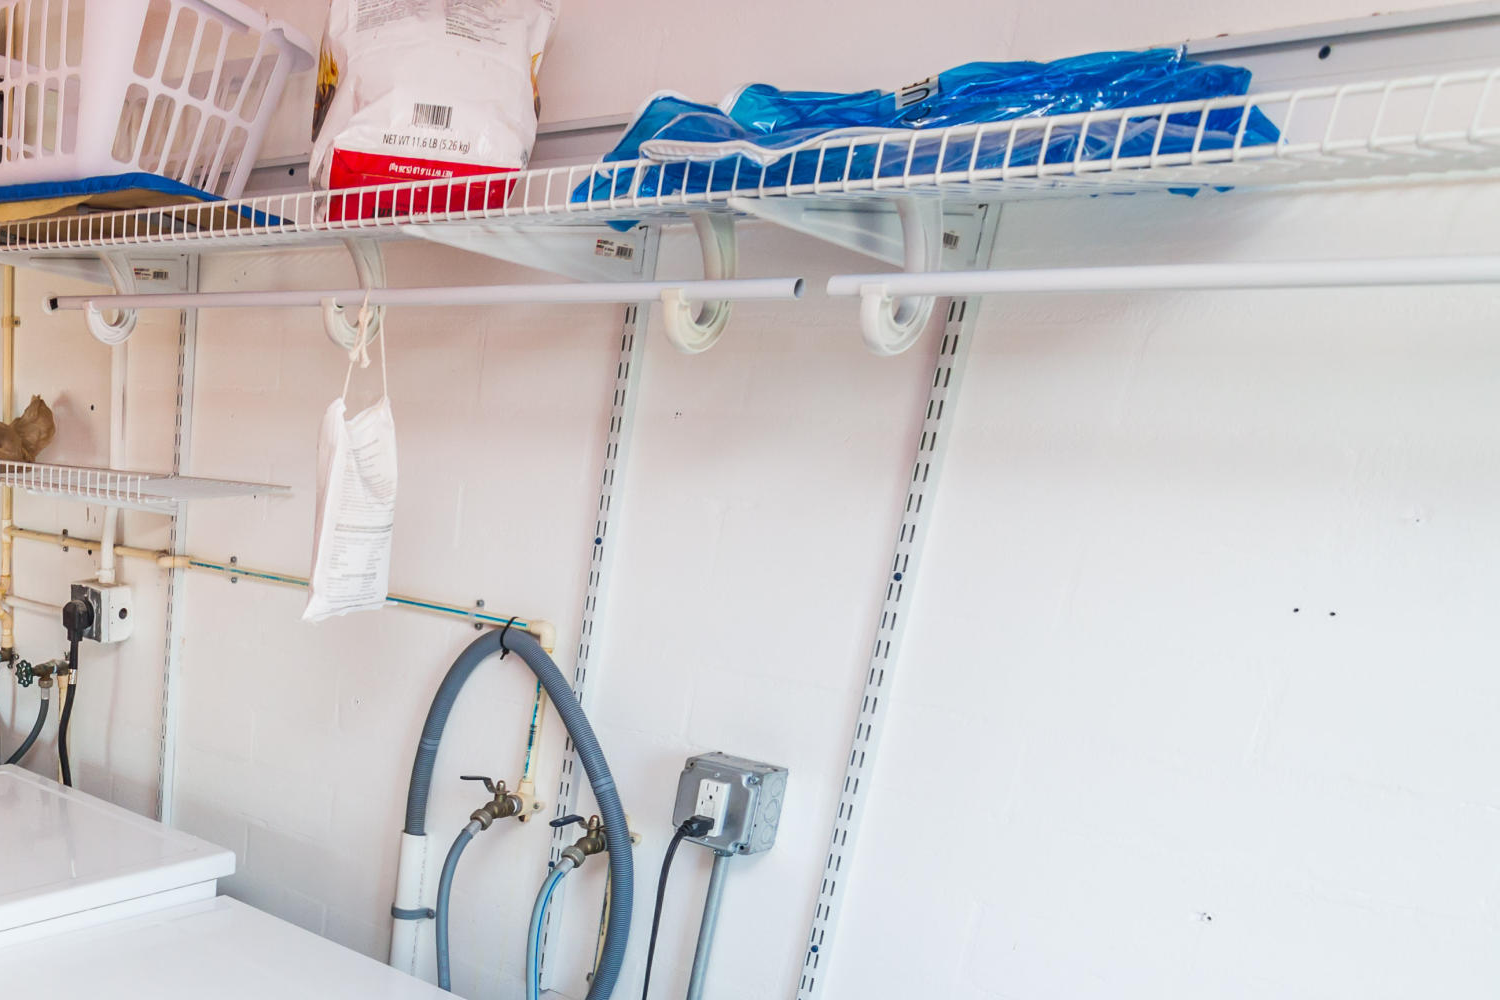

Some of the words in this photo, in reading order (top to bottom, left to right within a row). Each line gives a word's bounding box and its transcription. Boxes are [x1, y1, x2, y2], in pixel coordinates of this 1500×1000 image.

[382, 134, 397, 145] NET
[398, 136, 410, 145] WT
[412, 137, 427, 148] 11.6
[428, 138, 438, 148] LB
[439, 139, 457, 151] (5.26
[458, 141, 471, 155] kg)
